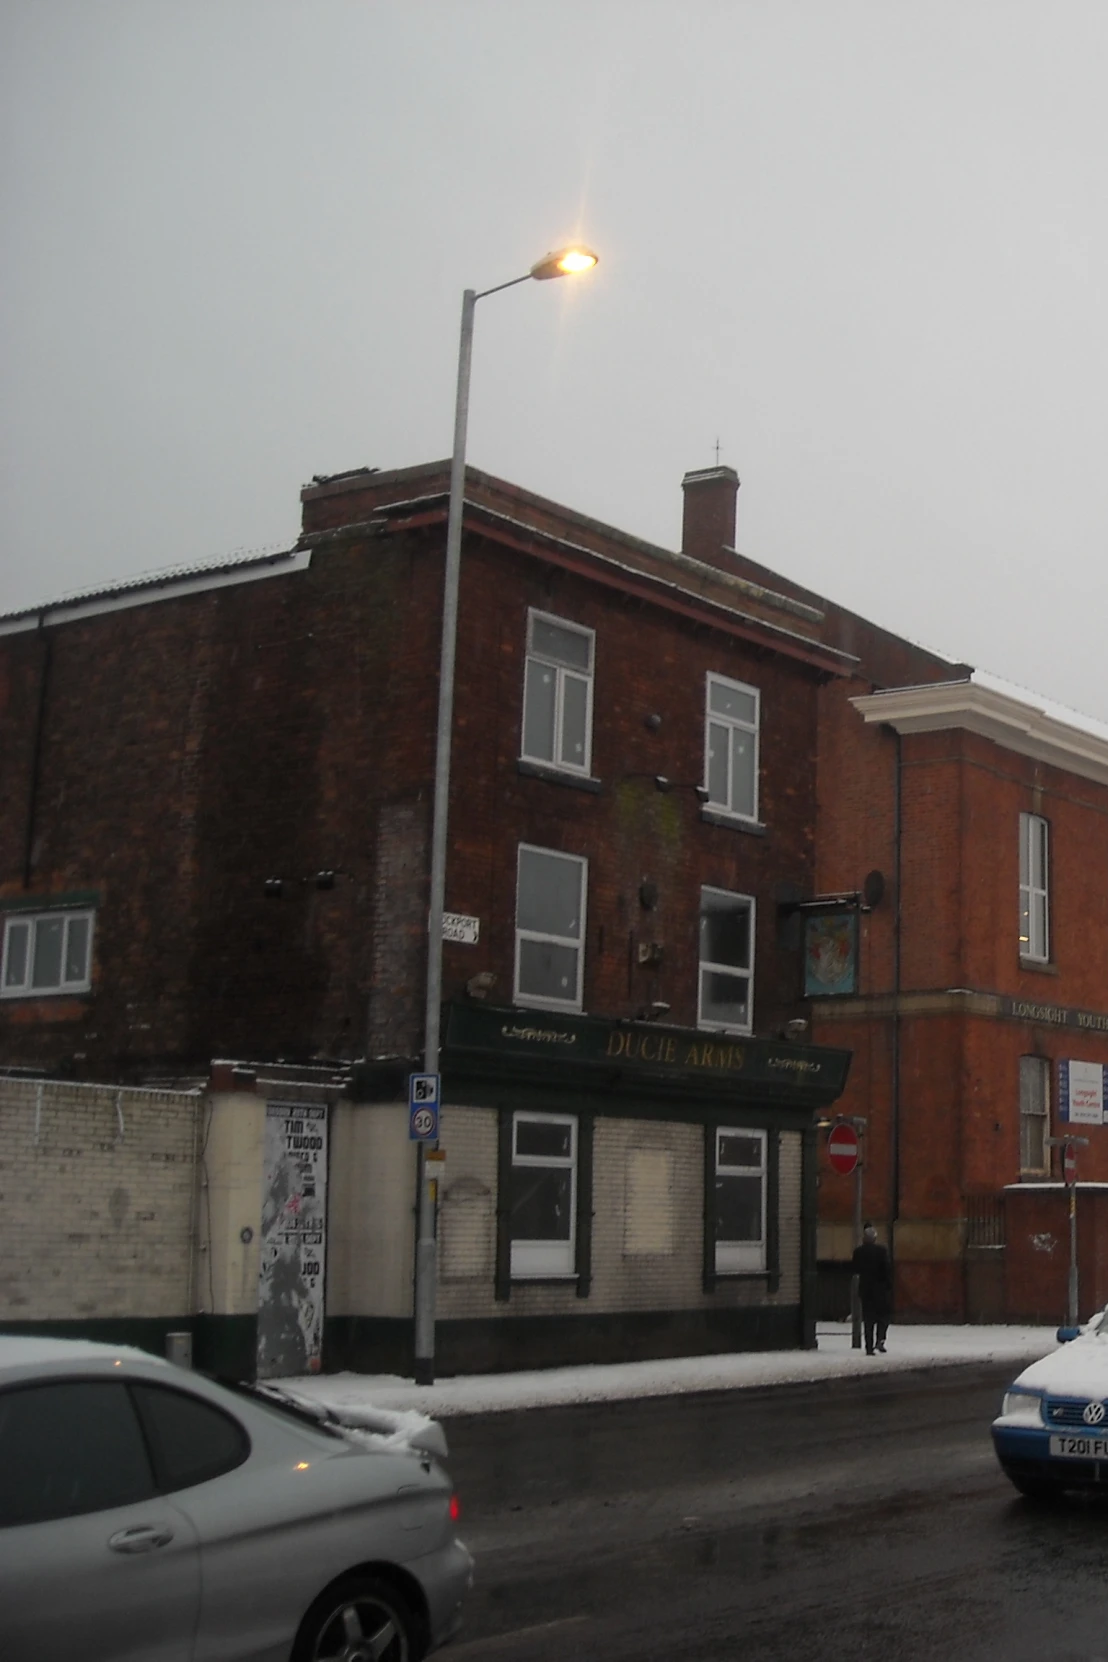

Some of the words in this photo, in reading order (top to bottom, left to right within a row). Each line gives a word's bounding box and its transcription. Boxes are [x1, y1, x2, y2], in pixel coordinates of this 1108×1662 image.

[441, 914, 478, 929] OCKPORT
[1012, 1001, 1068, 1024] LONGSIGHT
[1077, 1012, 1108, 1030] YOUTH
[606, 1031, 677, 1063] DUCIE
[684, 1042, 744, 1070] ARMS
[285, 1120, 304, 1134] TIM
[415, 1115, 432, 1129] 30
[287, 1135, 323, 1150] TWOOD
[1058, 1438, 1091, 1455] T201
